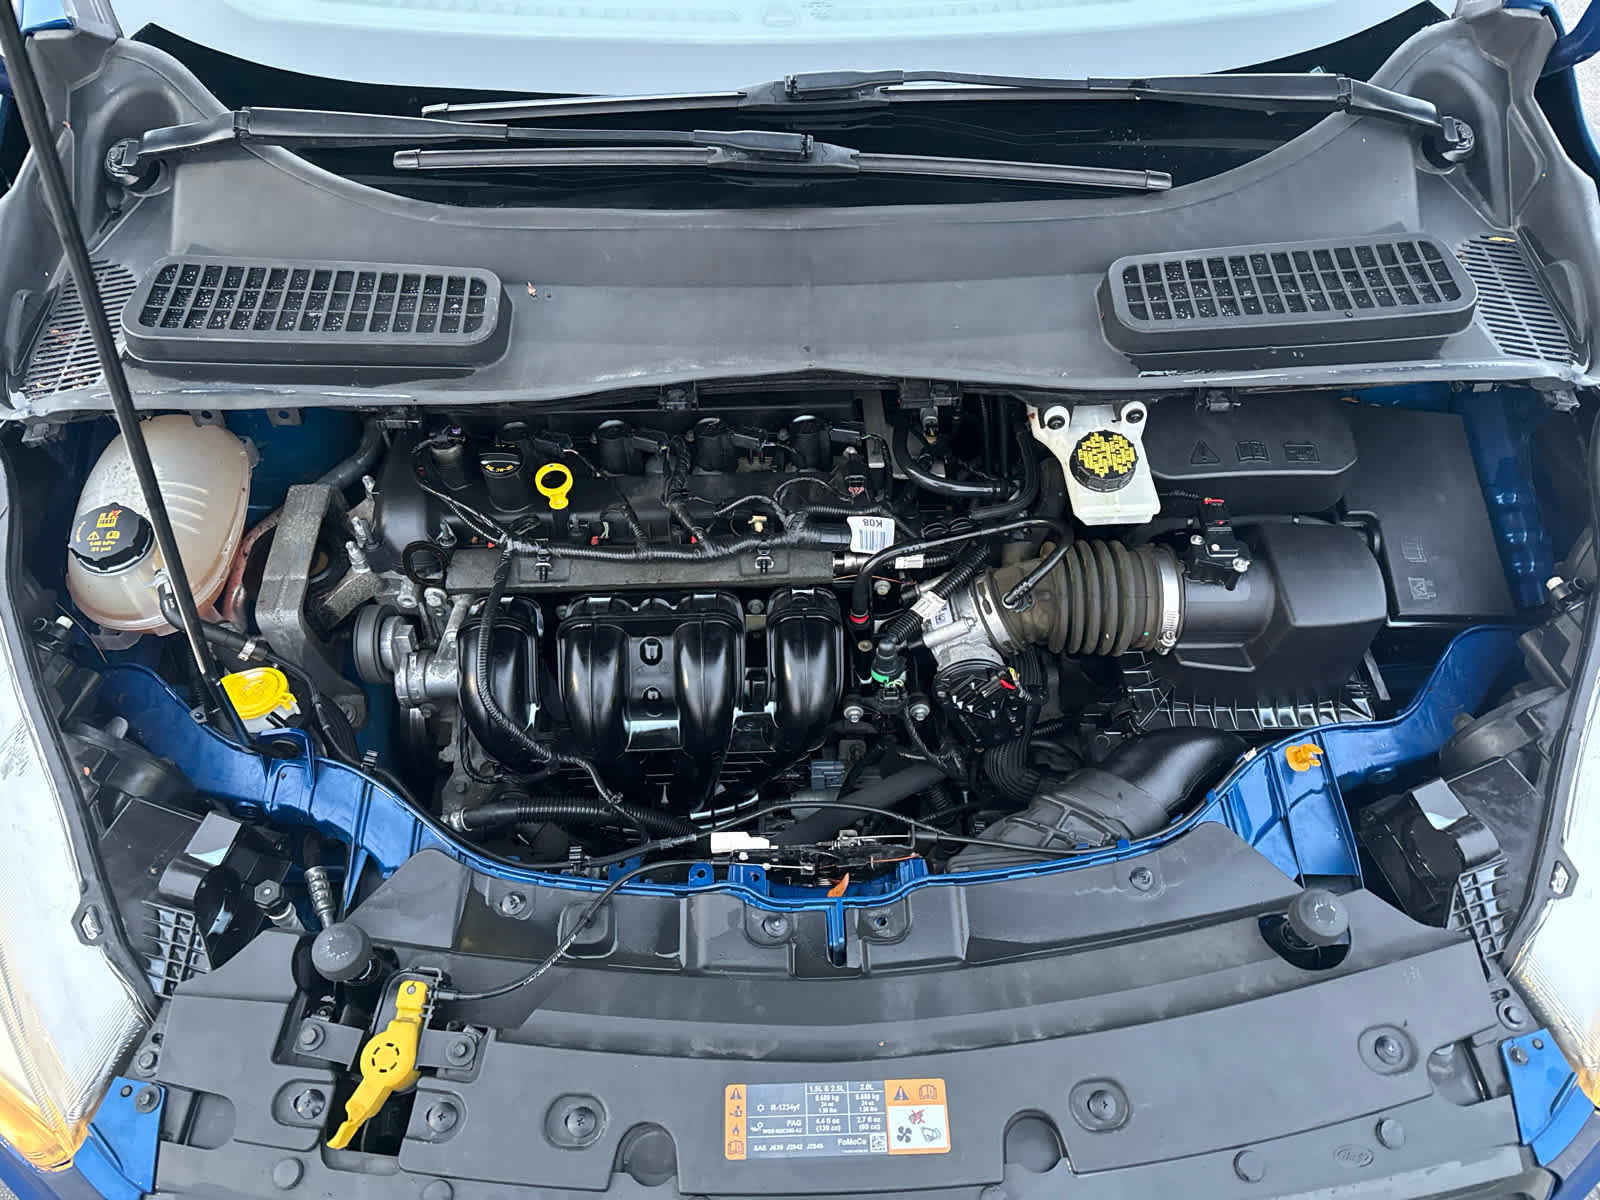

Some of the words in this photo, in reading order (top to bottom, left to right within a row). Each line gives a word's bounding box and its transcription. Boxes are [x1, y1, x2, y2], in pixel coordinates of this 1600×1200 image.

[863, 518, 883, 528] K08
[770, 1103, 800, 1113] R-1234yf
[786, 1119, 802, 1127] PAG
[837, 1137, 867, 1146] FoMoCo
[753, 1144, 767, 1152] SAE
